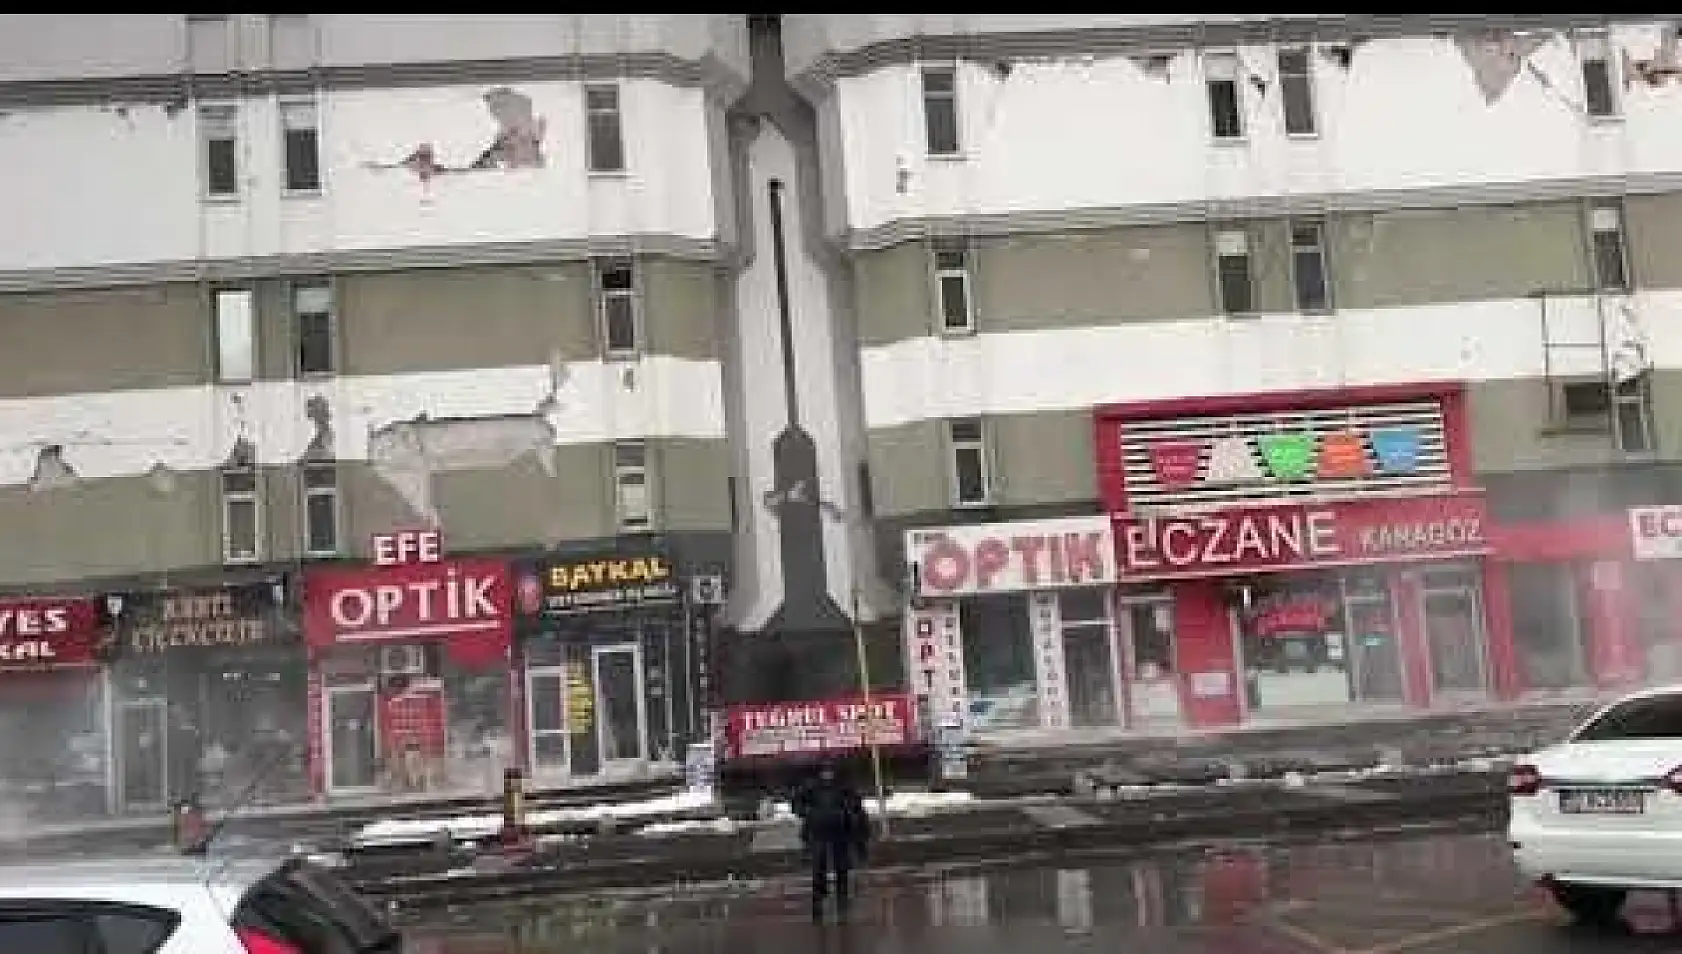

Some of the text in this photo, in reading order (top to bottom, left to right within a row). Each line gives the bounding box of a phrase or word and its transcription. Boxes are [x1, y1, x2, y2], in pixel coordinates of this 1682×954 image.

[372, 532, 440, 566] EFE
[1124, 511, 1341, 567] ECZANE
[549, 557, 672, 589] BAYKAL
[331, 568, 499, 626] OPTİK
